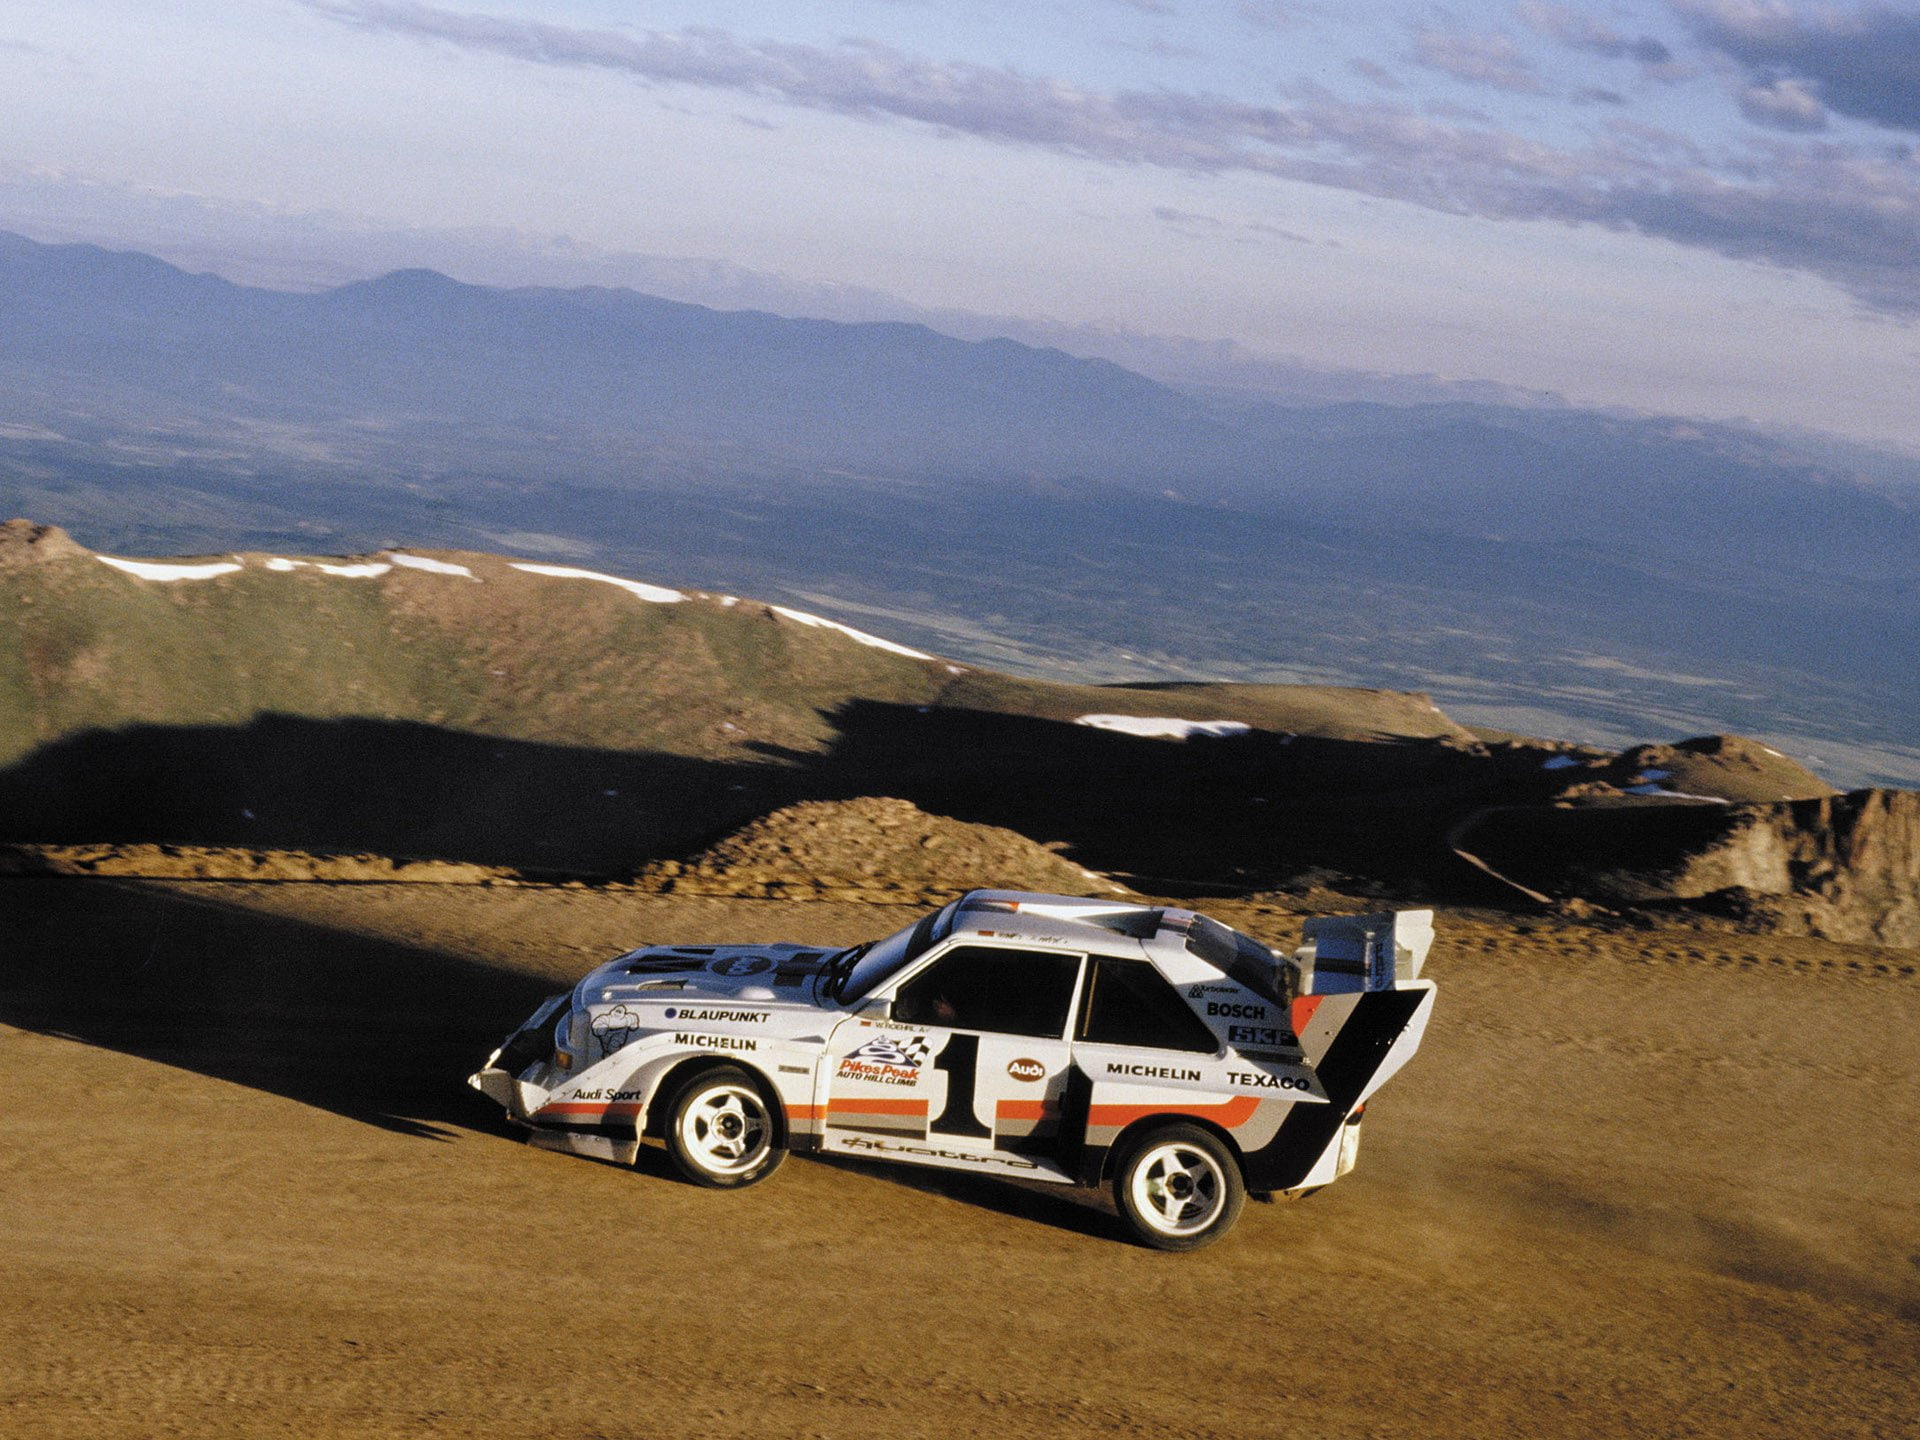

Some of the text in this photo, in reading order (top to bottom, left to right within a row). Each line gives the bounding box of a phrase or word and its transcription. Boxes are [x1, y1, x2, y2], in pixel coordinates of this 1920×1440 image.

[678, 1009, 771, 1023] BLAUPUNKT
[1207, 1002, 1265, 1020] BOSCH
[675, 1033, 757, 1051] MICHELIN
[1235, 1027, 1294, 1046] SKF
[840, 1059, 919, 1079] Pikes Peak
[1008, 1062, 1044, 1077] Audi
[1107, 1063, 1201, 1081] MICHELIN
[836, 1071, 917, 1087] AUTO HILL CLIMB
[930, 1032, 992, 1139] 1
[1227, 1072, 1310, 1090] TEXACO
[572, 1088, 641, 1101] Audi Sport
[842, 1136, 1038, 1170] quattro
